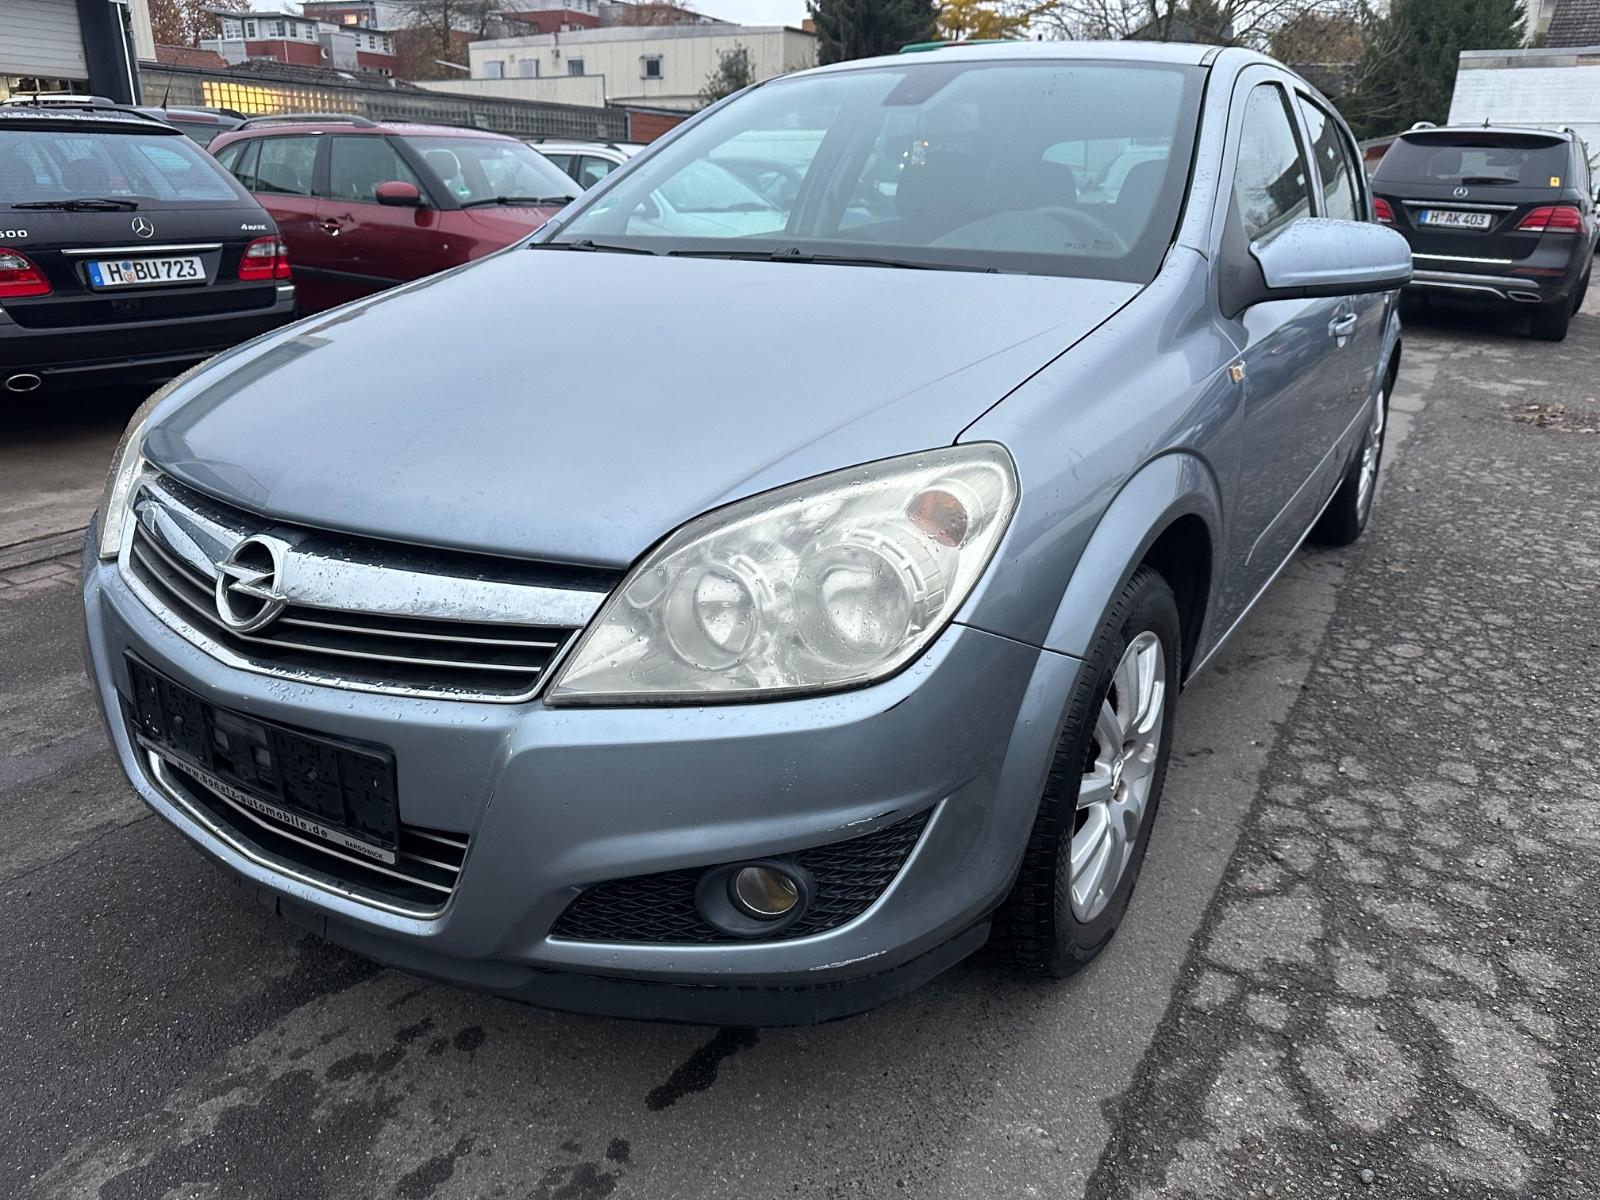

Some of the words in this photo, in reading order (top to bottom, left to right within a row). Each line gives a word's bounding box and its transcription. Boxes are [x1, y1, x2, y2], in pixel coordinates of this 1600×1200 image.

[1430, 211, 1440, 222] H
[1445, 212, 1461, 224] AK
[1462, 214, 1486, 225] 403
[107, 263, 123, 282] H
[133, 261, 160, 281] BU
[161, 260, 197, 279] 723
[177, 760, 328, 838] www.bonatz-automobile.de
